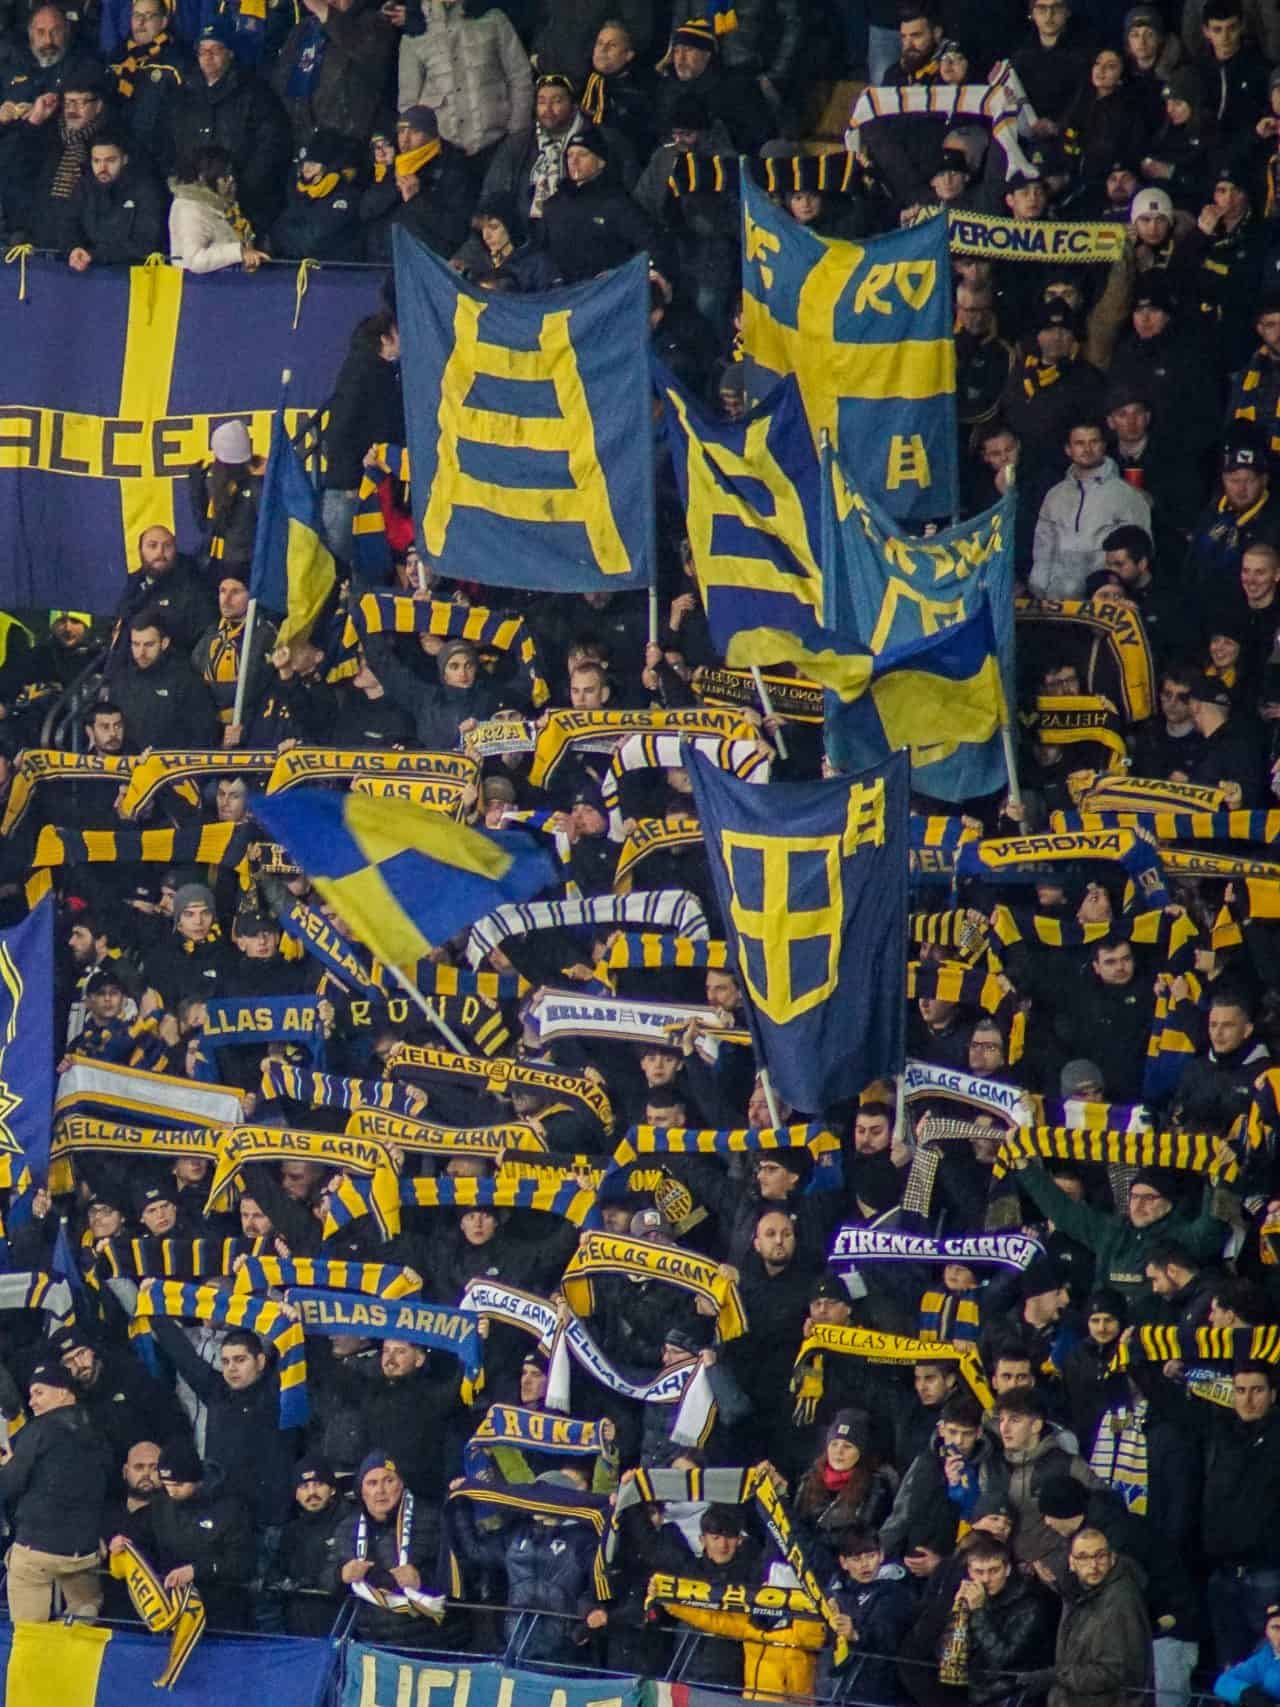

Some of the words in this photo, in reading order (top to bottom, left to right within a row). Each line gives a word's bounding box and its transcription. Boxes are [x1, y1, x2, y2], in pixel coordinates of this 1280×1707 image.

[950, 223, 1048, 253] VERONA
[1053, 227, 1092, 253] F.C.
[557, 709, 653, 731] HELLAS
[665, 711, 743, 734] ARMY
[466, 727, 520, 745] ORZA
[22, 754, 105, 781] HELLAS
[286, 754, 384, 774] HELLAS
[397, 757, 477, 780] ARMY
[632, 819, 700, 849] HELL
[993, 833, 1120, 858] VERONA
[203, 1007, 273, 1035] LLAS
[283, 1007, 315, 1031] AR
[546, 1005, 617, 1022] HELLAS
[395, 1047, 481, 1073] HELLAS
[513, 1068, 603, 1109] VERONA
[55, 1123, 143, 1144] HELLAS
[152, 1129, 220, 1147] ARMY
[224, 1131, 311, 1160] HELLAS
[360, 1116, 449, 1143] HELLAS
[454, 1130, 525, 1149] ARMY
[835, 1231, 938, 1255] FIRENZE
[945, 1238, 1038, 1267] CARICA
[578, 1242, 648, 1266] HELLAS
[657, 1257, 717, 1287] ARMY
[471, 1292, 519, 1313] HELLAS
[396, 1307, 475, 1344] ARMY
[813, 1325, 885, 1350] HELLAS
[477, 1408, 596, 1445] ERONA
[130, 1568, 162, 1621] HELL
